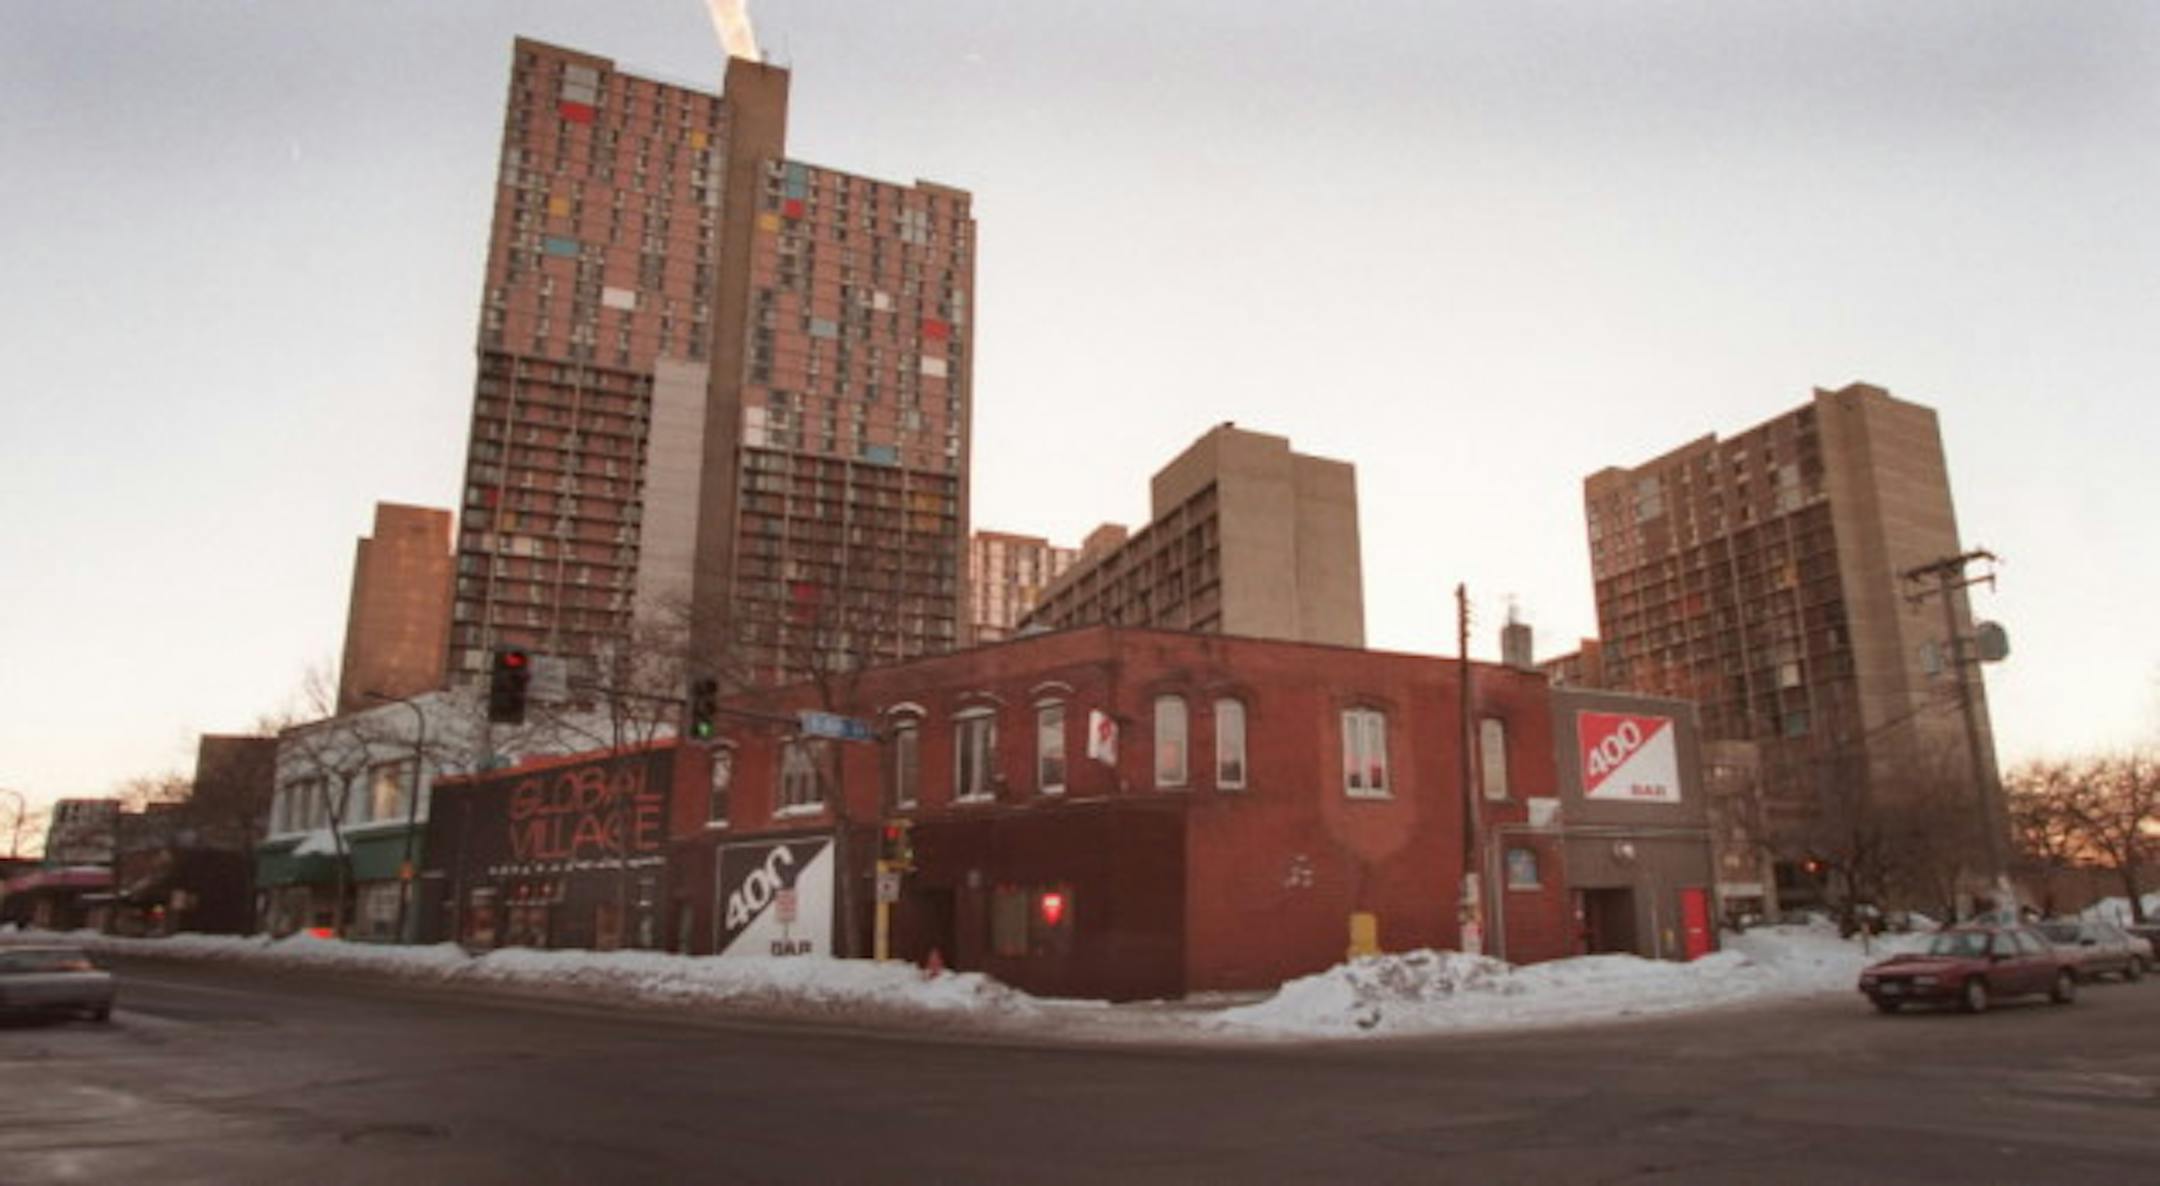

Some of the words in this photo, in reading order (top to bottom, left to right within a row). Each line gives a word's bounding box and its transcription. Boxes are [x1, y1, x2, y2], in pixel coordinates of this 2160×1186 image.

[1589, 719, 1641, 776] 400
[509, 763, 647, 821] GLOBAL
[509, 794, 662, 862] VILLAGE
